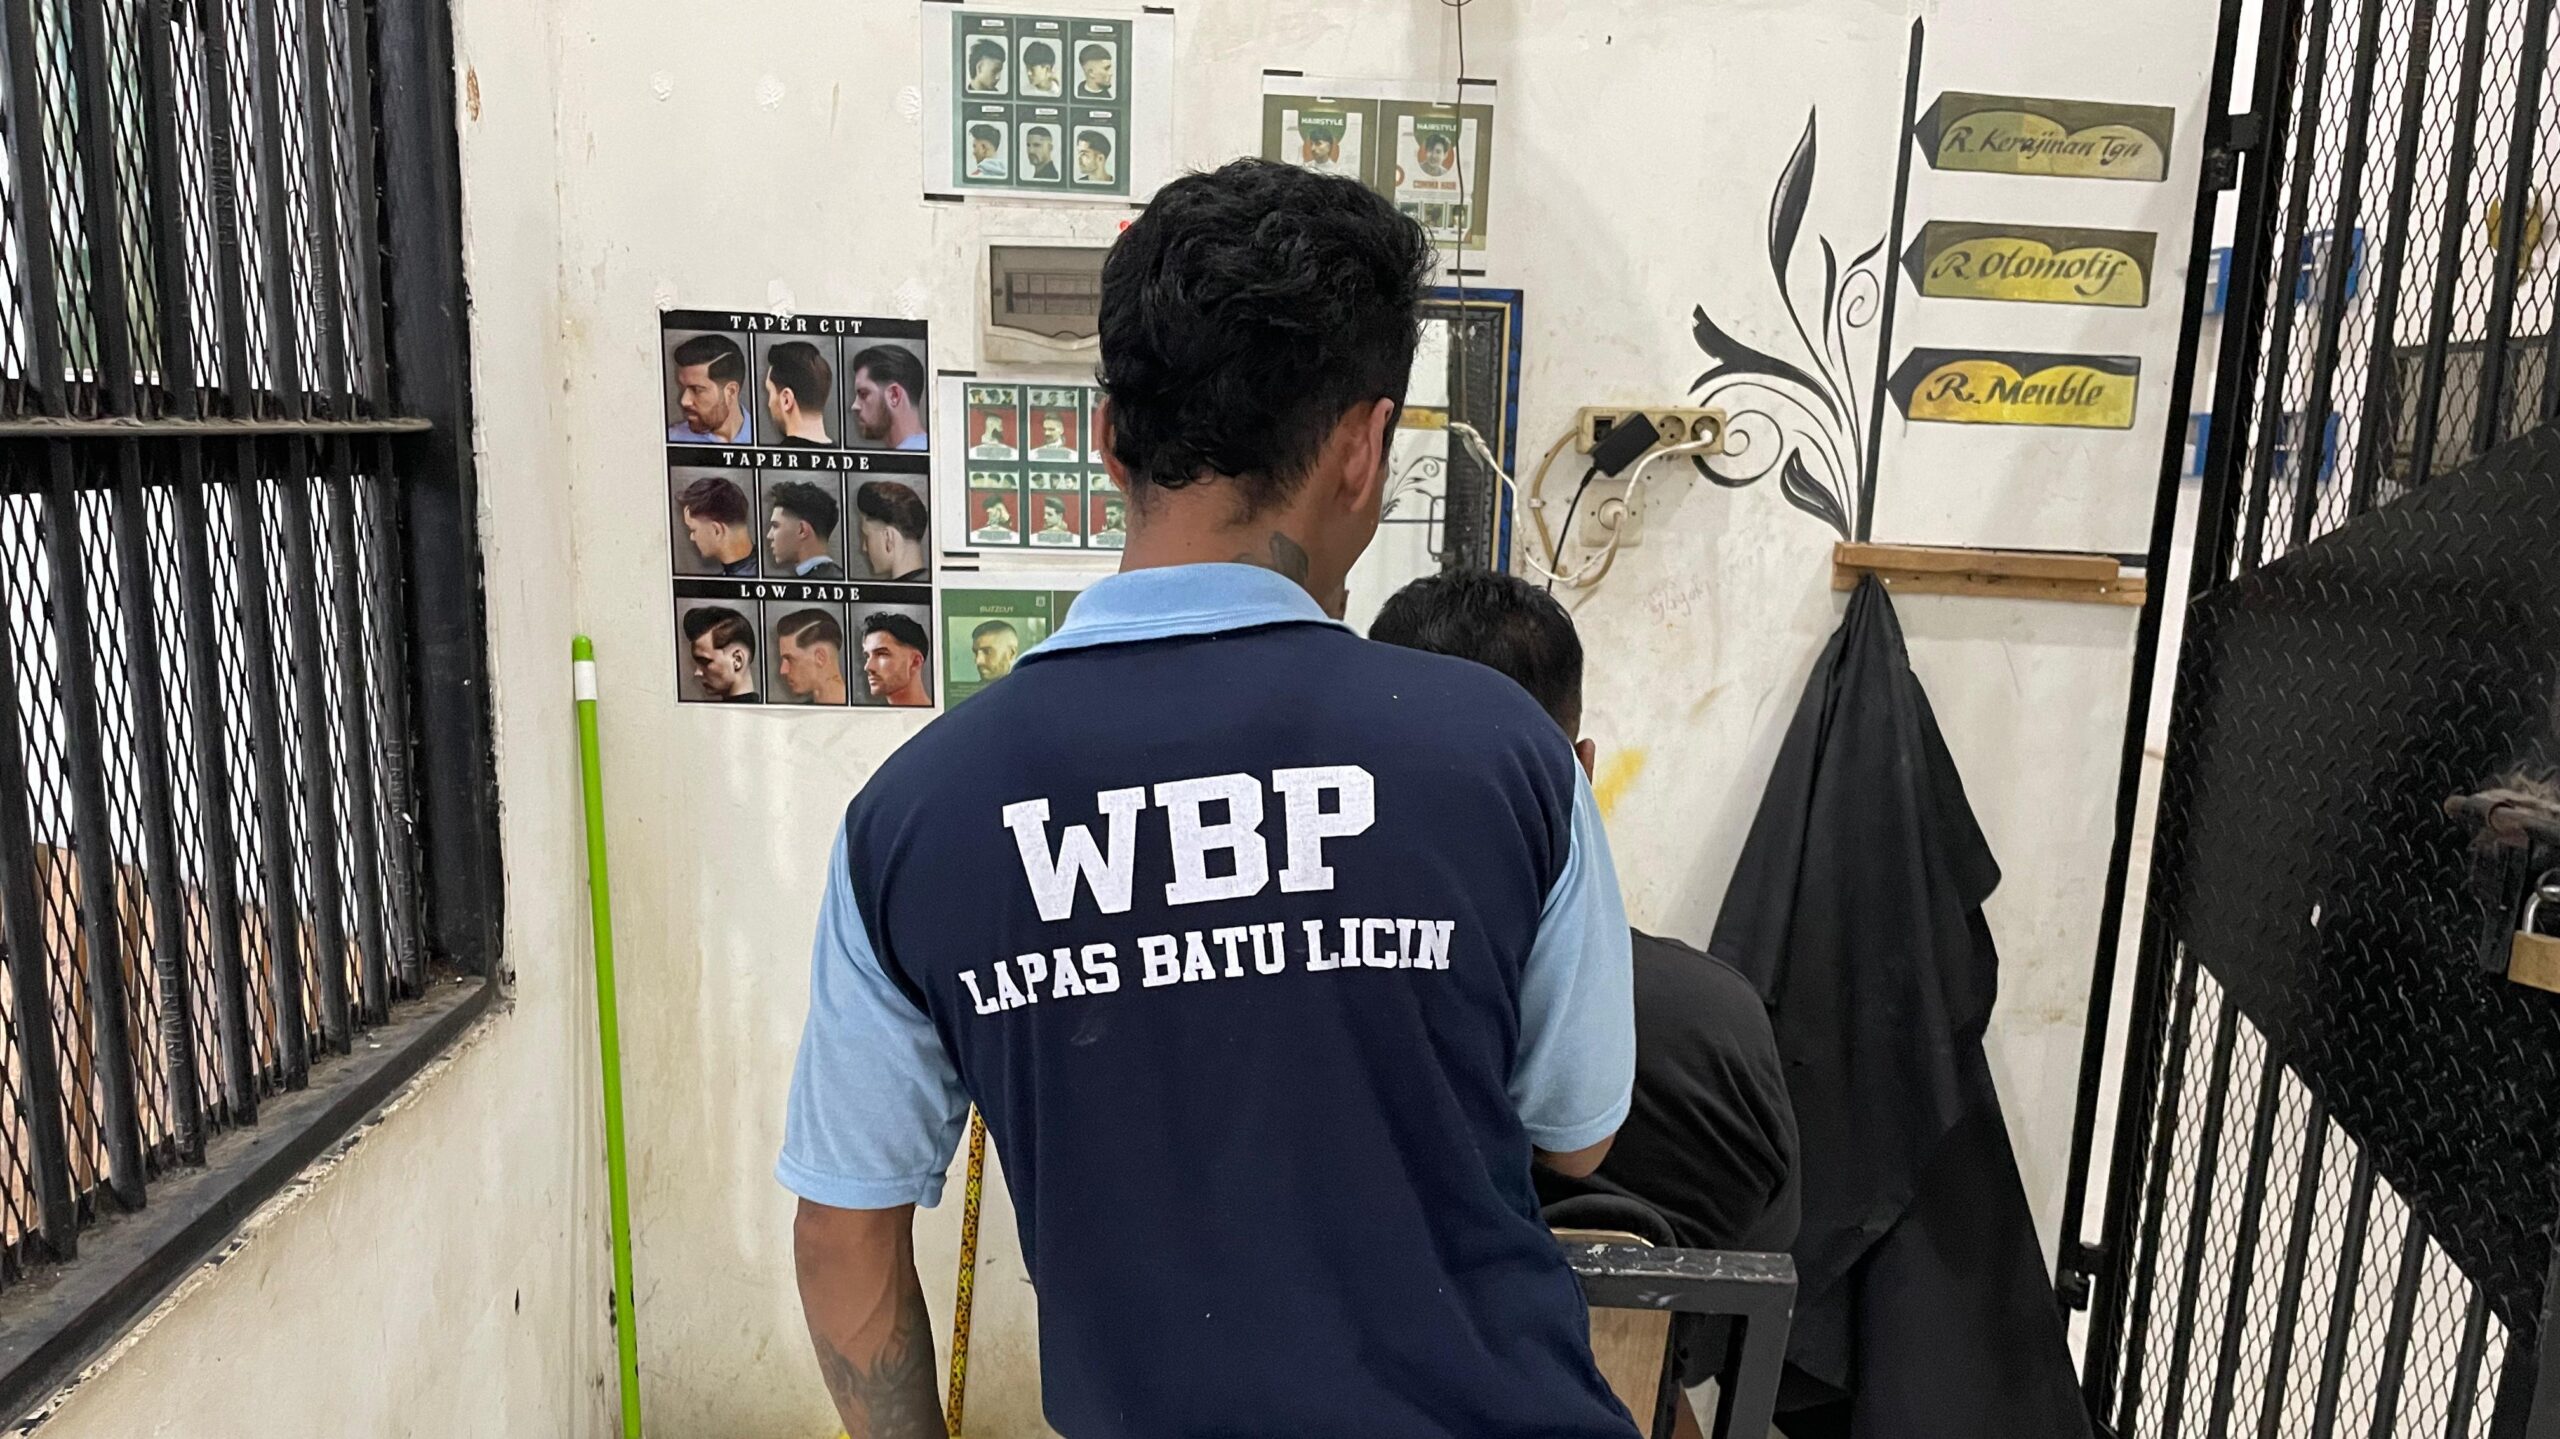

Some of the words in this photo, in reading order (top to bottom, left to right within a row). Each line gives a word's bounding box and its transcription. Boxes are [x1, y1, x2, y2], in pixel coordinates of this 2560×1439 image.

[1301, 117, 1344, 126] HAIRSTYLE
[1980, 128, 2099, 160] Kerajinan
[2100, 136, 2143, 166] Tgn
[1978, 246, 2127, 296] Otomotif
[730, 315, 808, 332] TAPER
[820, 319, 863, 334] CUT
[1926, 373, 1981, 404] R.
[1987, 372, 2103, 407] Meuble
[722, 452, 798, 469] TAPER
[811, 456, 870, 470] PADE
[740, 584, 787, 598] LOW
[802, 586, 860, 601] PADE
[1002, 765, 1375, 922] WBP
[959, 943, 1120, 1015] LAPAS
[1138, 922, 1285, 988] BATU
[1303, 918, 1455, 972] LICIN
